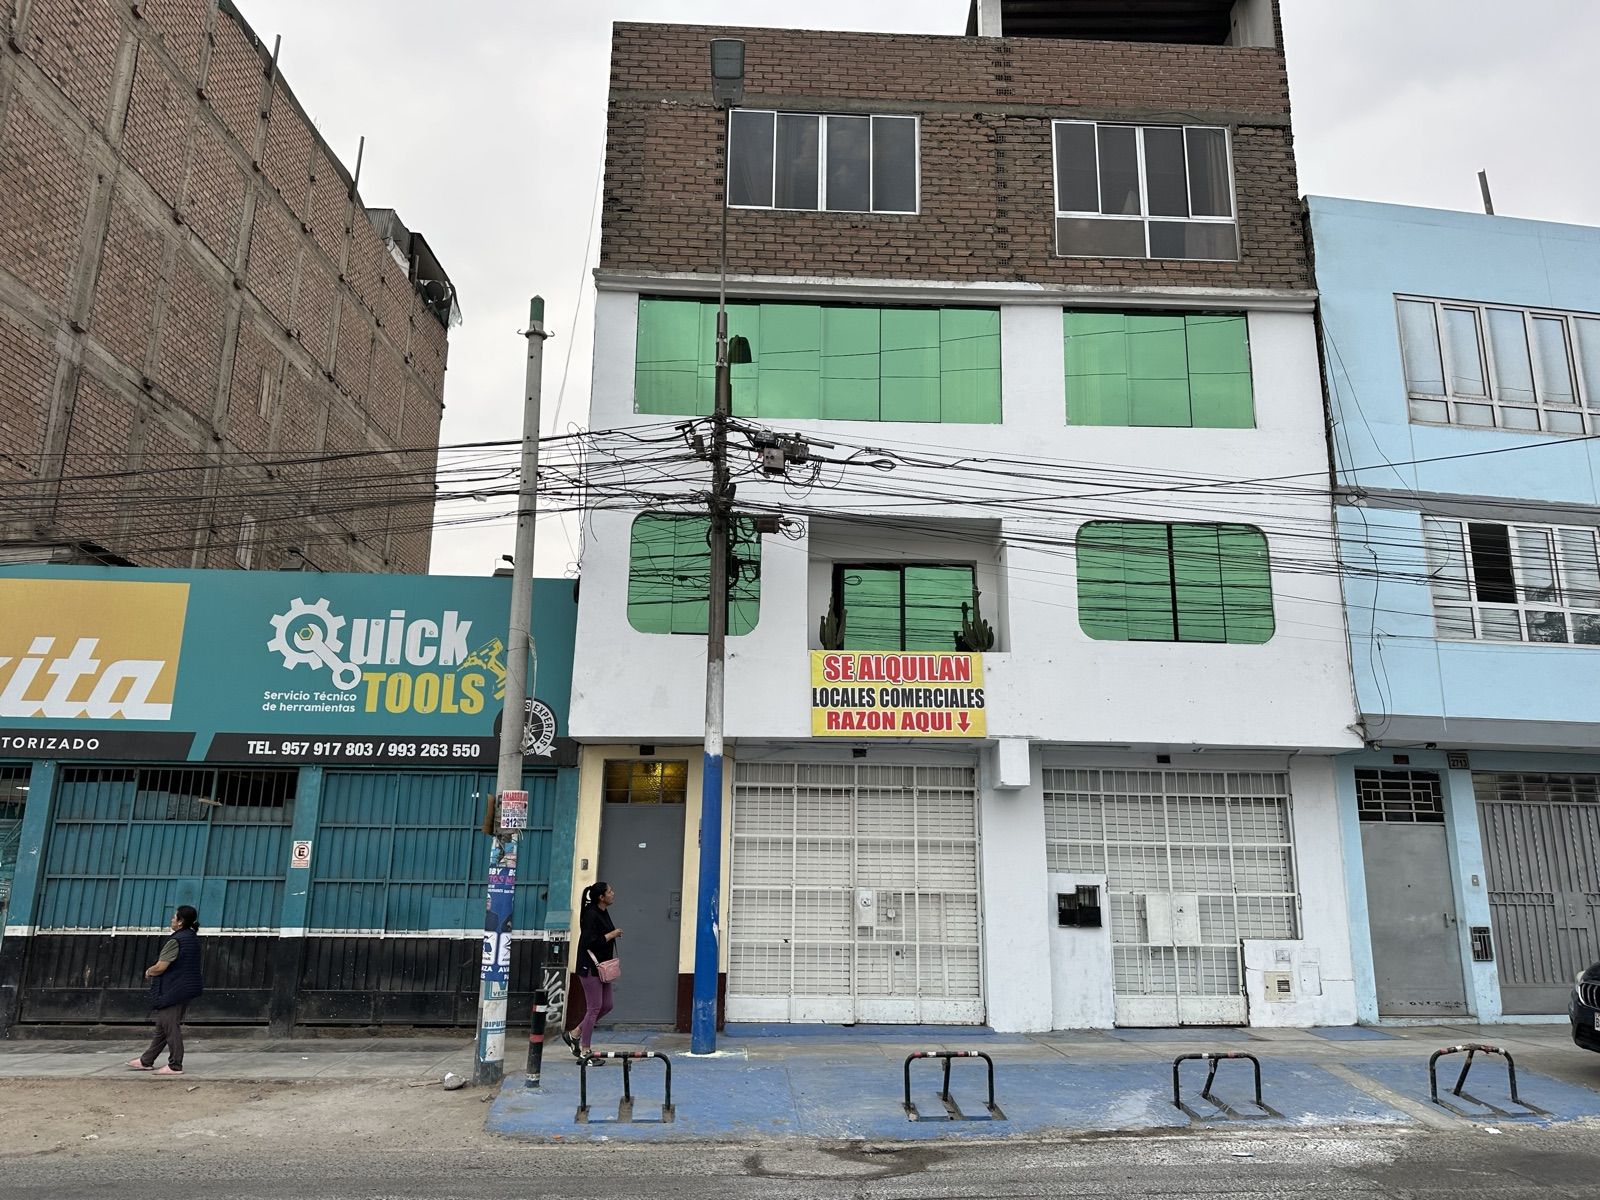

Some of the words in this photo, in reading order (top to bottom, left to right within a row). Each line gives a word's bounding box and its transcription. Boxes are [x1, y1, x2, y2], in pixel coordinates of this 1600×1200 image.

[824, 654, 854, 682] SE
[857, 655, 971, 685] ALQUILAN
[263, 690, 310, 701] Servicio
[313, 691, 357, 702] Técnico
[362, 672, 486, 714] TOOLS
[812, 687, 876, 707] LOCALES
[879, 687, 985, 708] COMERCIALES
[262, 703, 276, 712] de
[279, 703, 356, 713] herramientas
[533, 703, 553, 747] EXPERTOS
[826, 711, 896, 731] RAZON
[901, 711, 953, 732] AQUI
[247, 740, 277, 755] TEL.
[281, 741, 309, 756] 957
[313, 742, 342, 756] 917
[345, 742, 373, 756] 803
[388, 743, 416, 757] 993
[420, 743, 449, 757] 263
[452, 743, 480, 758] 550
[298, 847, 306, 857] E
